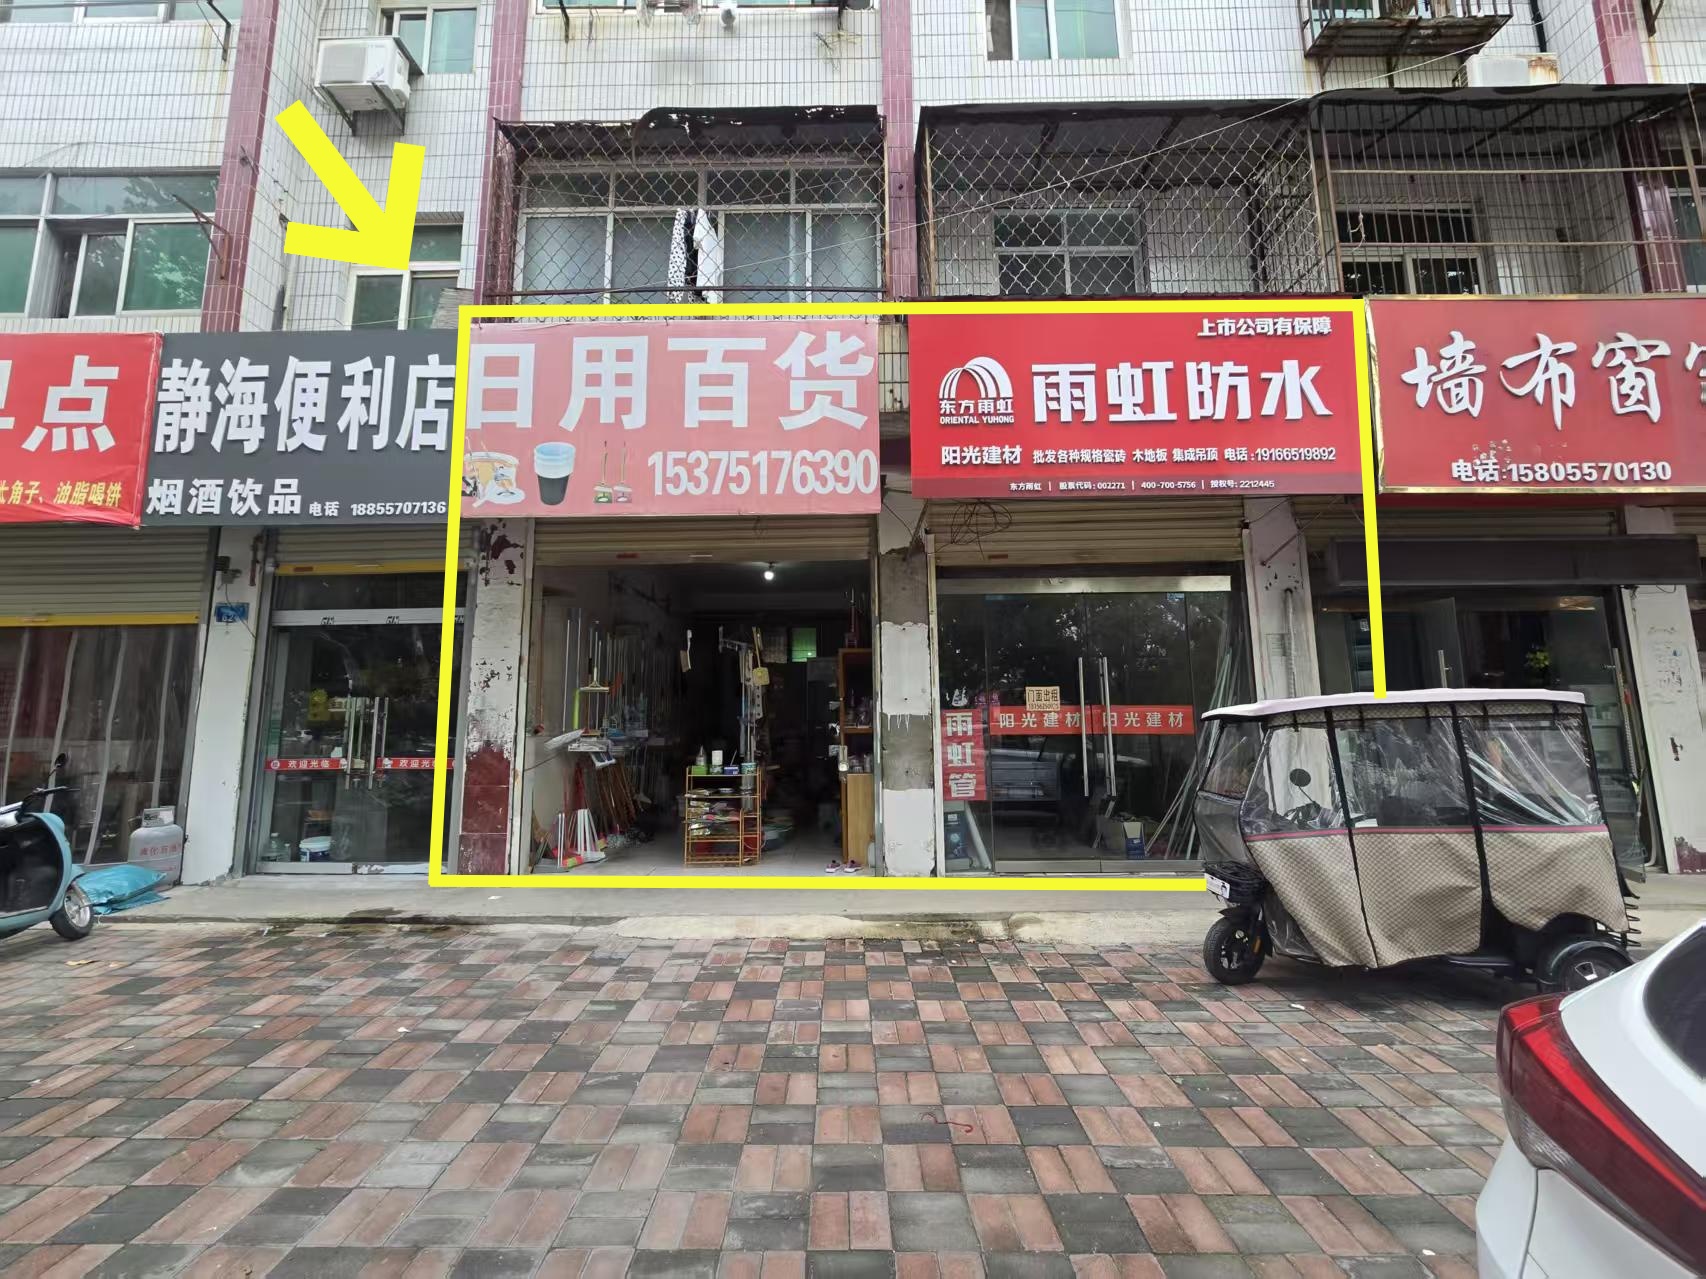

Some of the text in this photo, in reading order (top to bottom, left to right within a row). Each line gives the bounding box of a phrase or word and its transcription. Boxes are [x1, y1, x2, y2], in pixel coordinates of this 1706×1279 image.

[1196, 315, 1333, 337] 上市公司有保障
[465, 330, 875, 432] 日用百货
[1031, 358, 1334, 424] 雨虹防水
[1400, 330, 1706, 431] 墙布窗
[0, 354, 120, 453] 点
[153, 353, 457, 454] 静海便利店
[939, 398, 1015, 415] 东方雨虹
[939, 415, 1015, 425] ORIENTAL YUHONG
[941, 444, 1023, 465] 阳光建材
[1032, 448, 1127, 464] 批发各种规格瓷砖
[1132, 447, 1168, 463] 木地板
[1172, 447, 1219, 462] 集成吊顶
[647, 448, 879, 497] 15375176390
[1009, 481, 1043, 491] 东方雨虹
[1140, 480, 1197, 490] 400-700-5756
[145, 477, 303, 516] 烟酒饮品
[308, 500, 447, 518] 电话 18855707136
[999, 711, 1082, 729] 阳光建材
[287, 759, 331, 770] 欢迎光临
[399, 759, 437, 769] 欢迎光
[945, 712, 977, 798] 雨虹管
